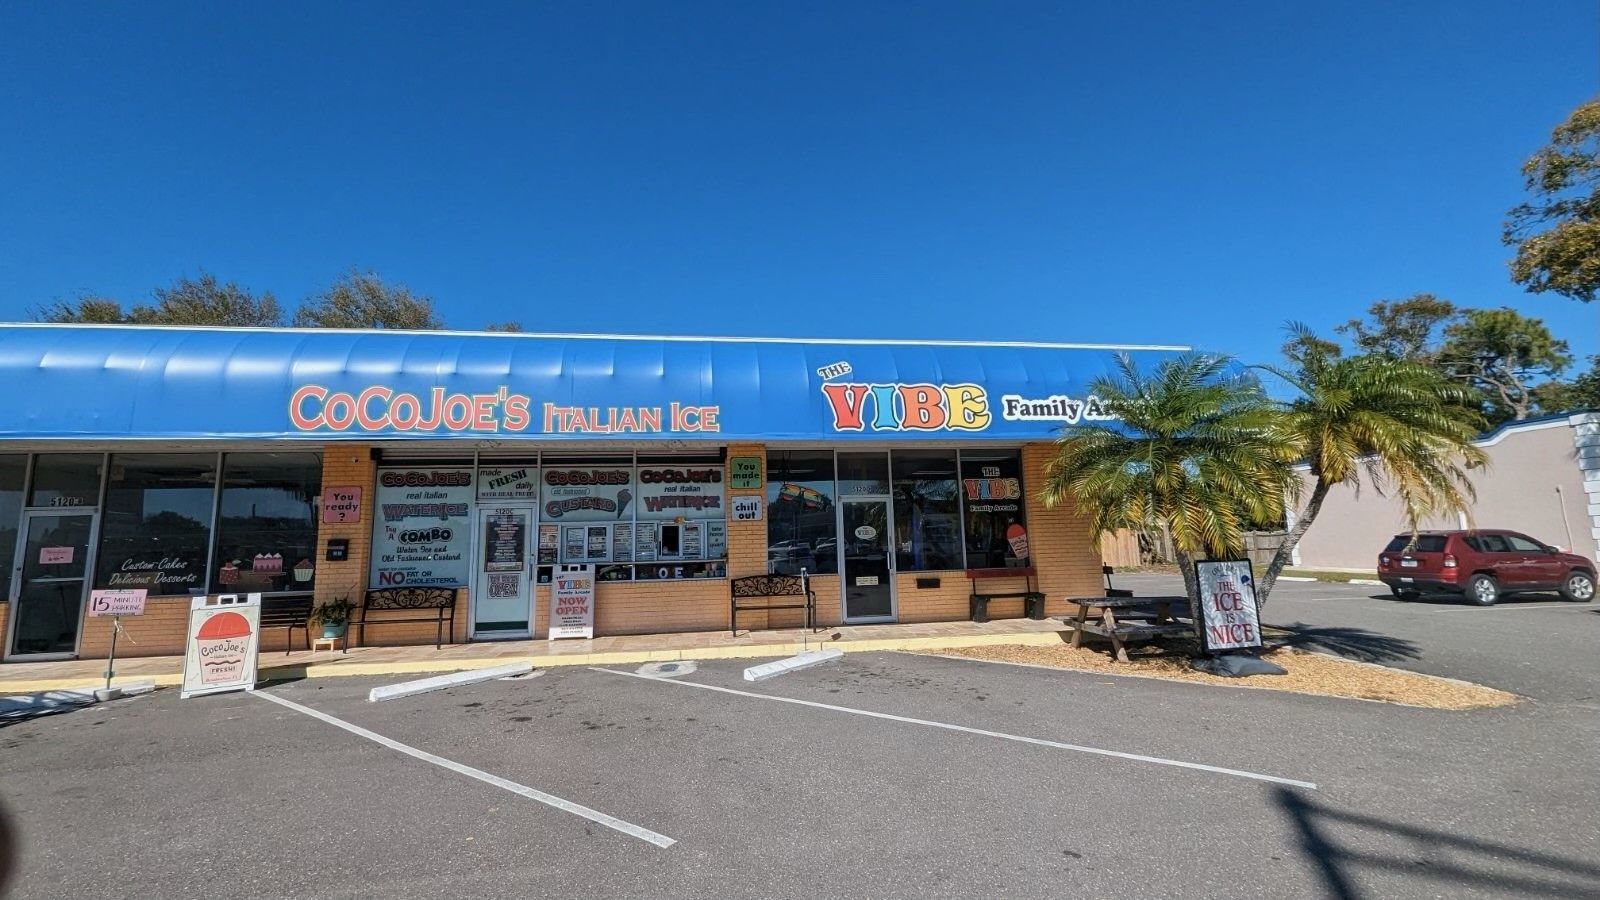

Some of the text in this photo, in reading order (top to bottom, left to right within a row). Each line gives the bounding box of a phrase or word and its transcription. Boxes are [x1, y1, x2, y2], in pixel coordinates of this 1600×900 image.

[817, 361, 851, 380] THE
[821, 383, 991, 432] VIBE
[1003, 395, 1081, 424] Family
[543, 402, 661, 434] ITALIAN
[671, 401, 720, 432] ICE
[480, 469, 502, 477] made
[982, 466, 1000, 477] THE
[488, 469, 528, 490] FRESH
[515, 482, 534, 491] daily
[964, 478, 1020, 500] VIBE
[333, 493, 354, 501] You
[424, 491, 448, 499] italian
[325, 502, 359, 512] ready
[735, 502, 757, 511] chill
[400, 528, 452, 542] COMBO
[121, 558, 188, 570] Custom Cakes
[109, 572, 198, 585] Delicious Desserts
[379, 571, 406, 585] NO
[558, 579, 591, 589] VIBE
[1217, 581, 1236, 591] THE
[92, 596, 110, 612] 15
[558, 596, 587, 606] NOW
[1213, 593, 1244, 611] ICE
[555, 606, 589, 615] OPEN
[1226, 613, 1236, 623] IS
[1211, 624, 1255, 644] NICE
